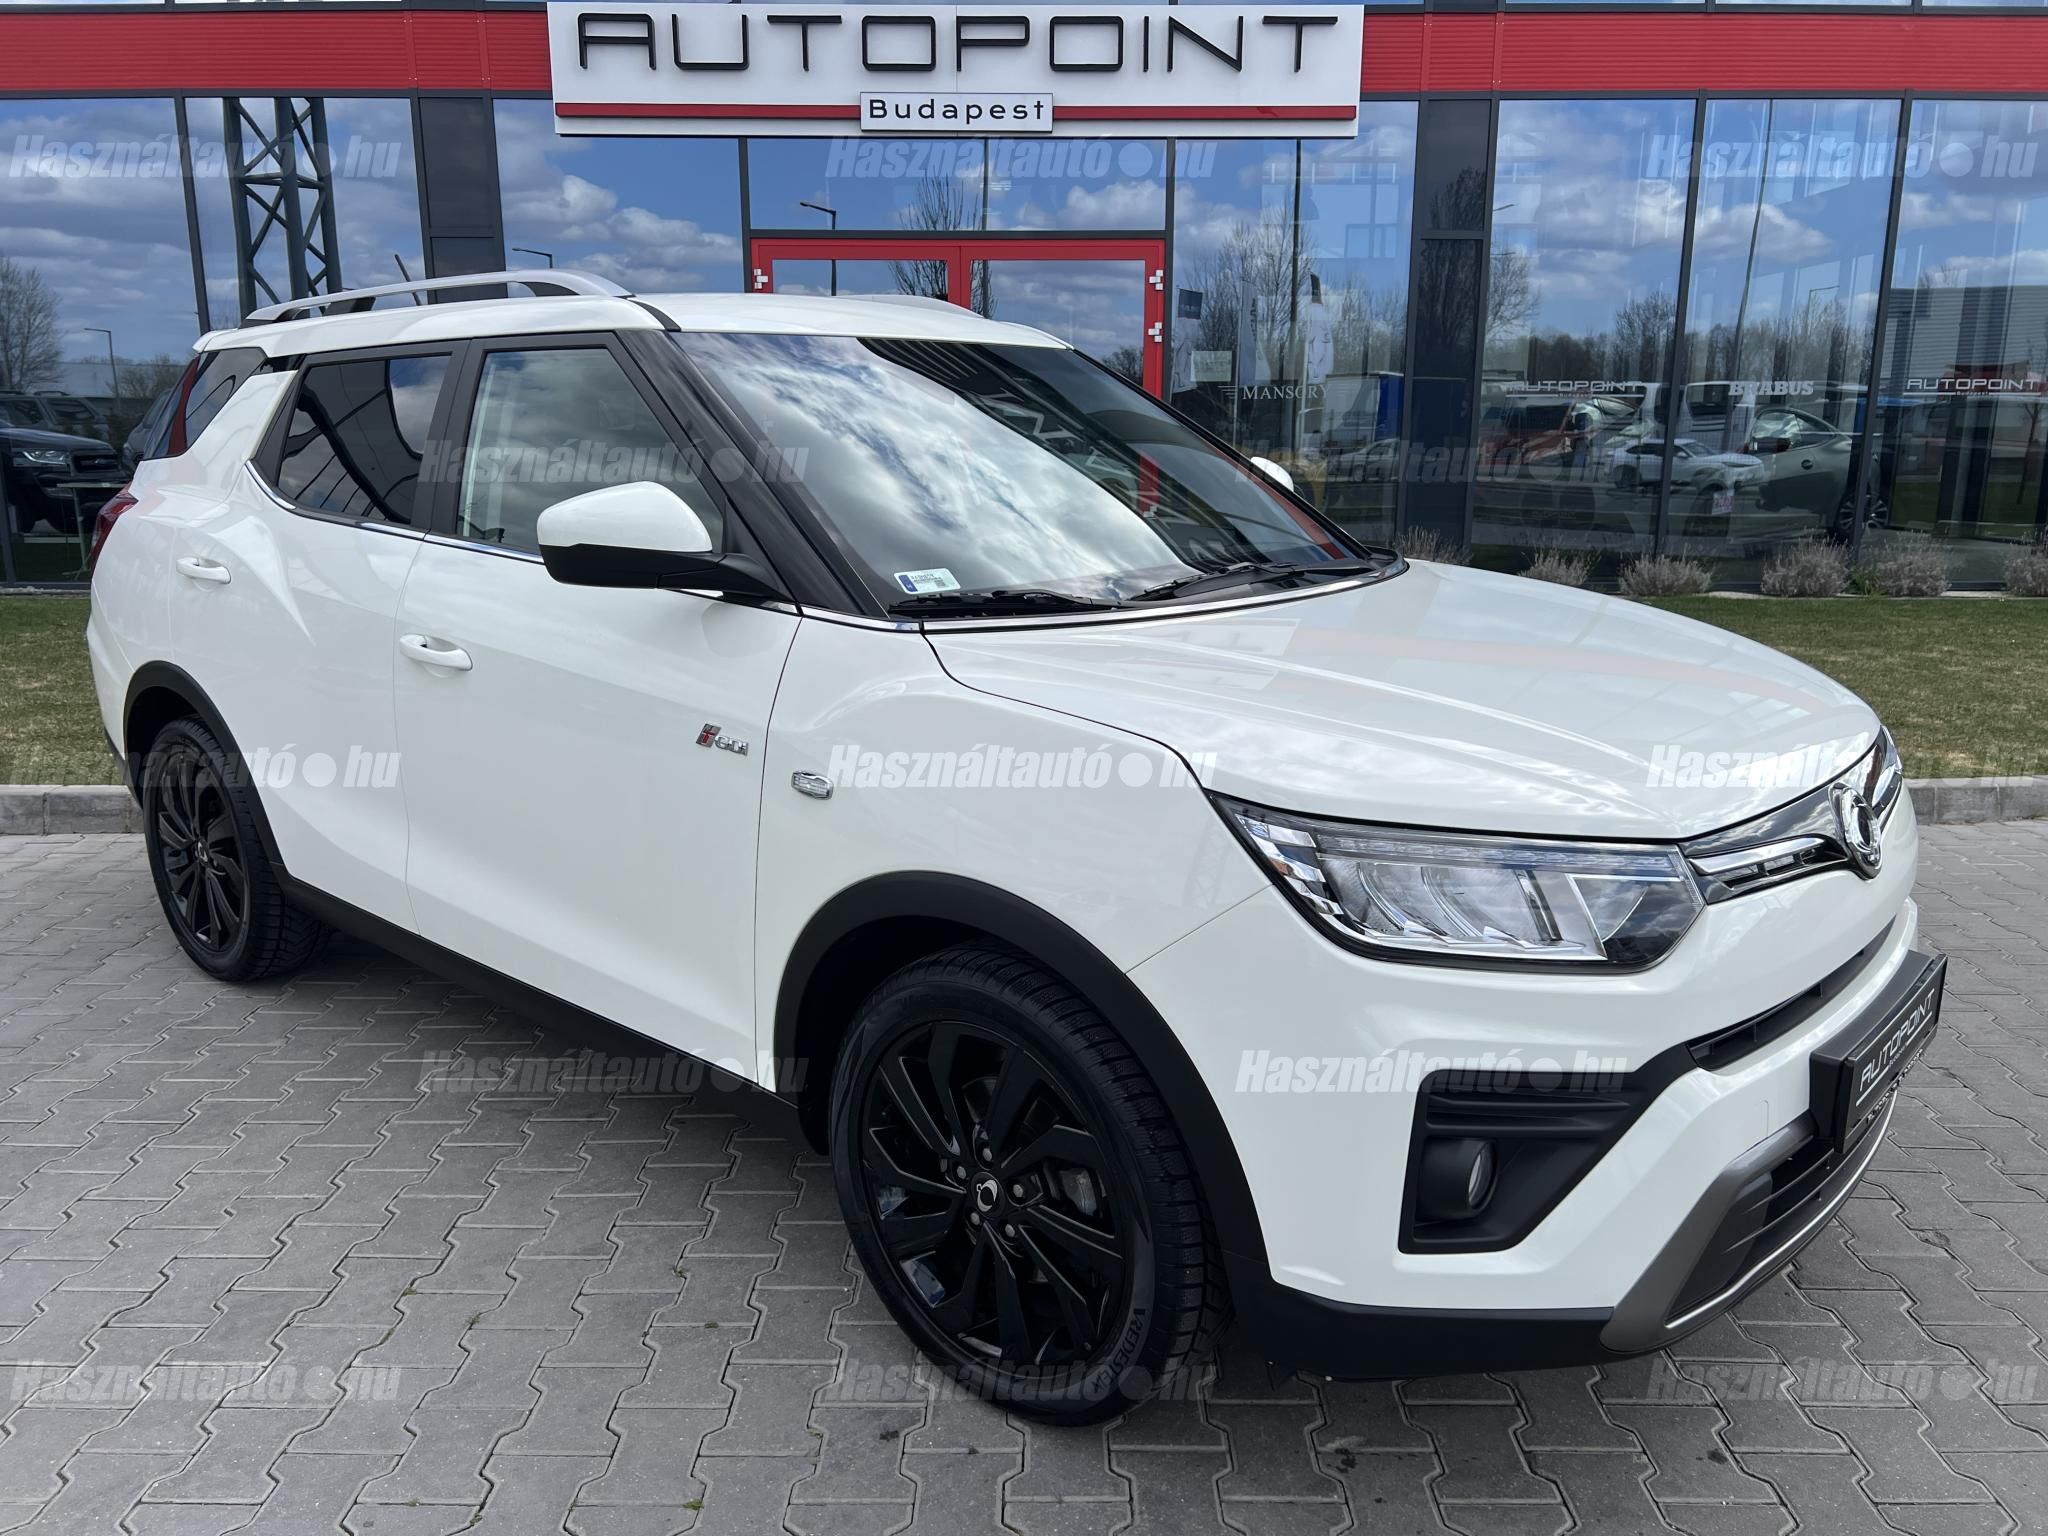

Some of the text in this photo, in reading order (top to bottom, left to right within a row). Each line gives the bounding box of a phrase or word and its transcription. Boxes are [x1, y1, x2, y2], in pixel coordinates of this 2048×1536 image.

[577, 13, 1339, 73] AUTOPOINT
[868, 98, 1044, 125] Budapest
[1508, 380, 1643, 392] AUTOPOINT
[1728, 380, 1814, 396] BRABUS
[1906, 378, 2037, 390] AUTOPOINT
[1242, 385, 1329, 400] MANSORY
[1858, 987, 1935, 1092] AUTOPOINT
